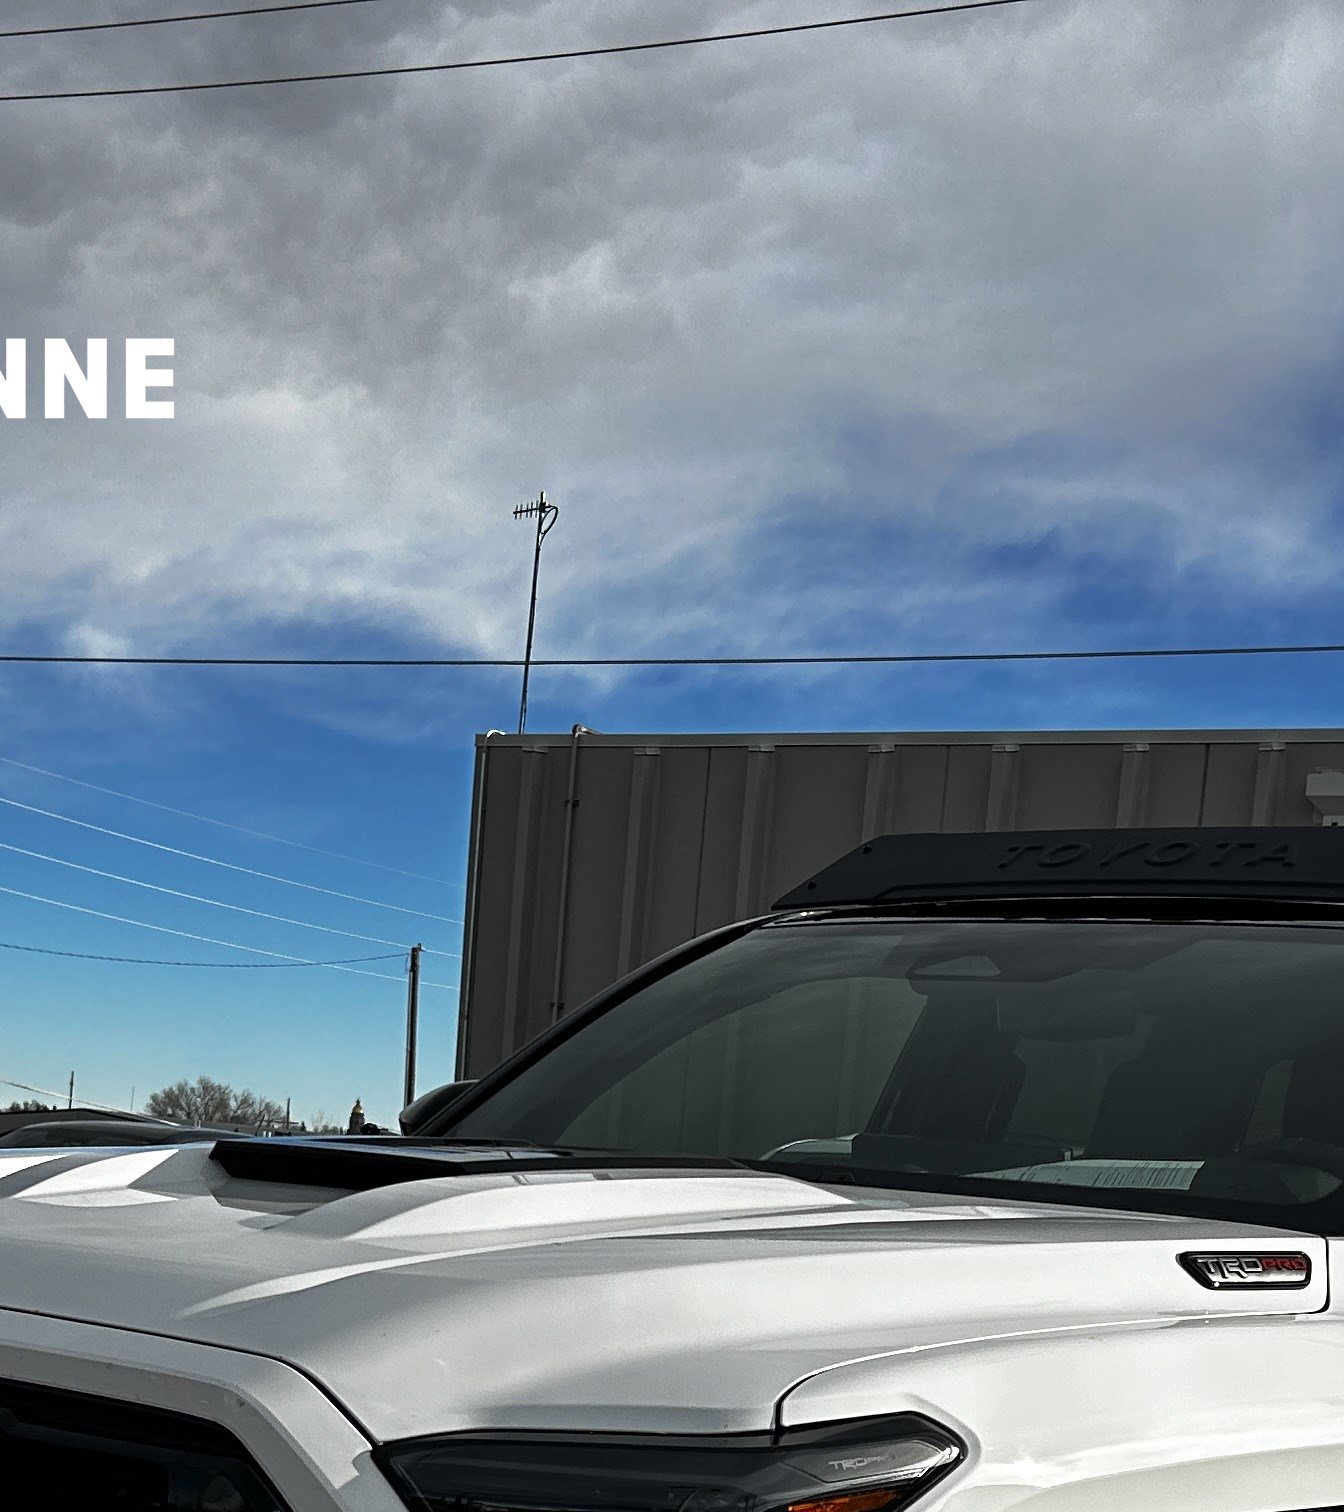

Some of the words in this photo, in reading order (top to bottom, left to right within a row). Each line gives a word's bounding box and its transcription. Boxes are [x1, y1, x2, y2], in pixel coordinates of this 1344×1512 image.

[997, 839, 1299, 869] TOYOTA
[1197, 1257, 1263, 1279] TRD
[1261, 1257, 1308, 1271] PRO
